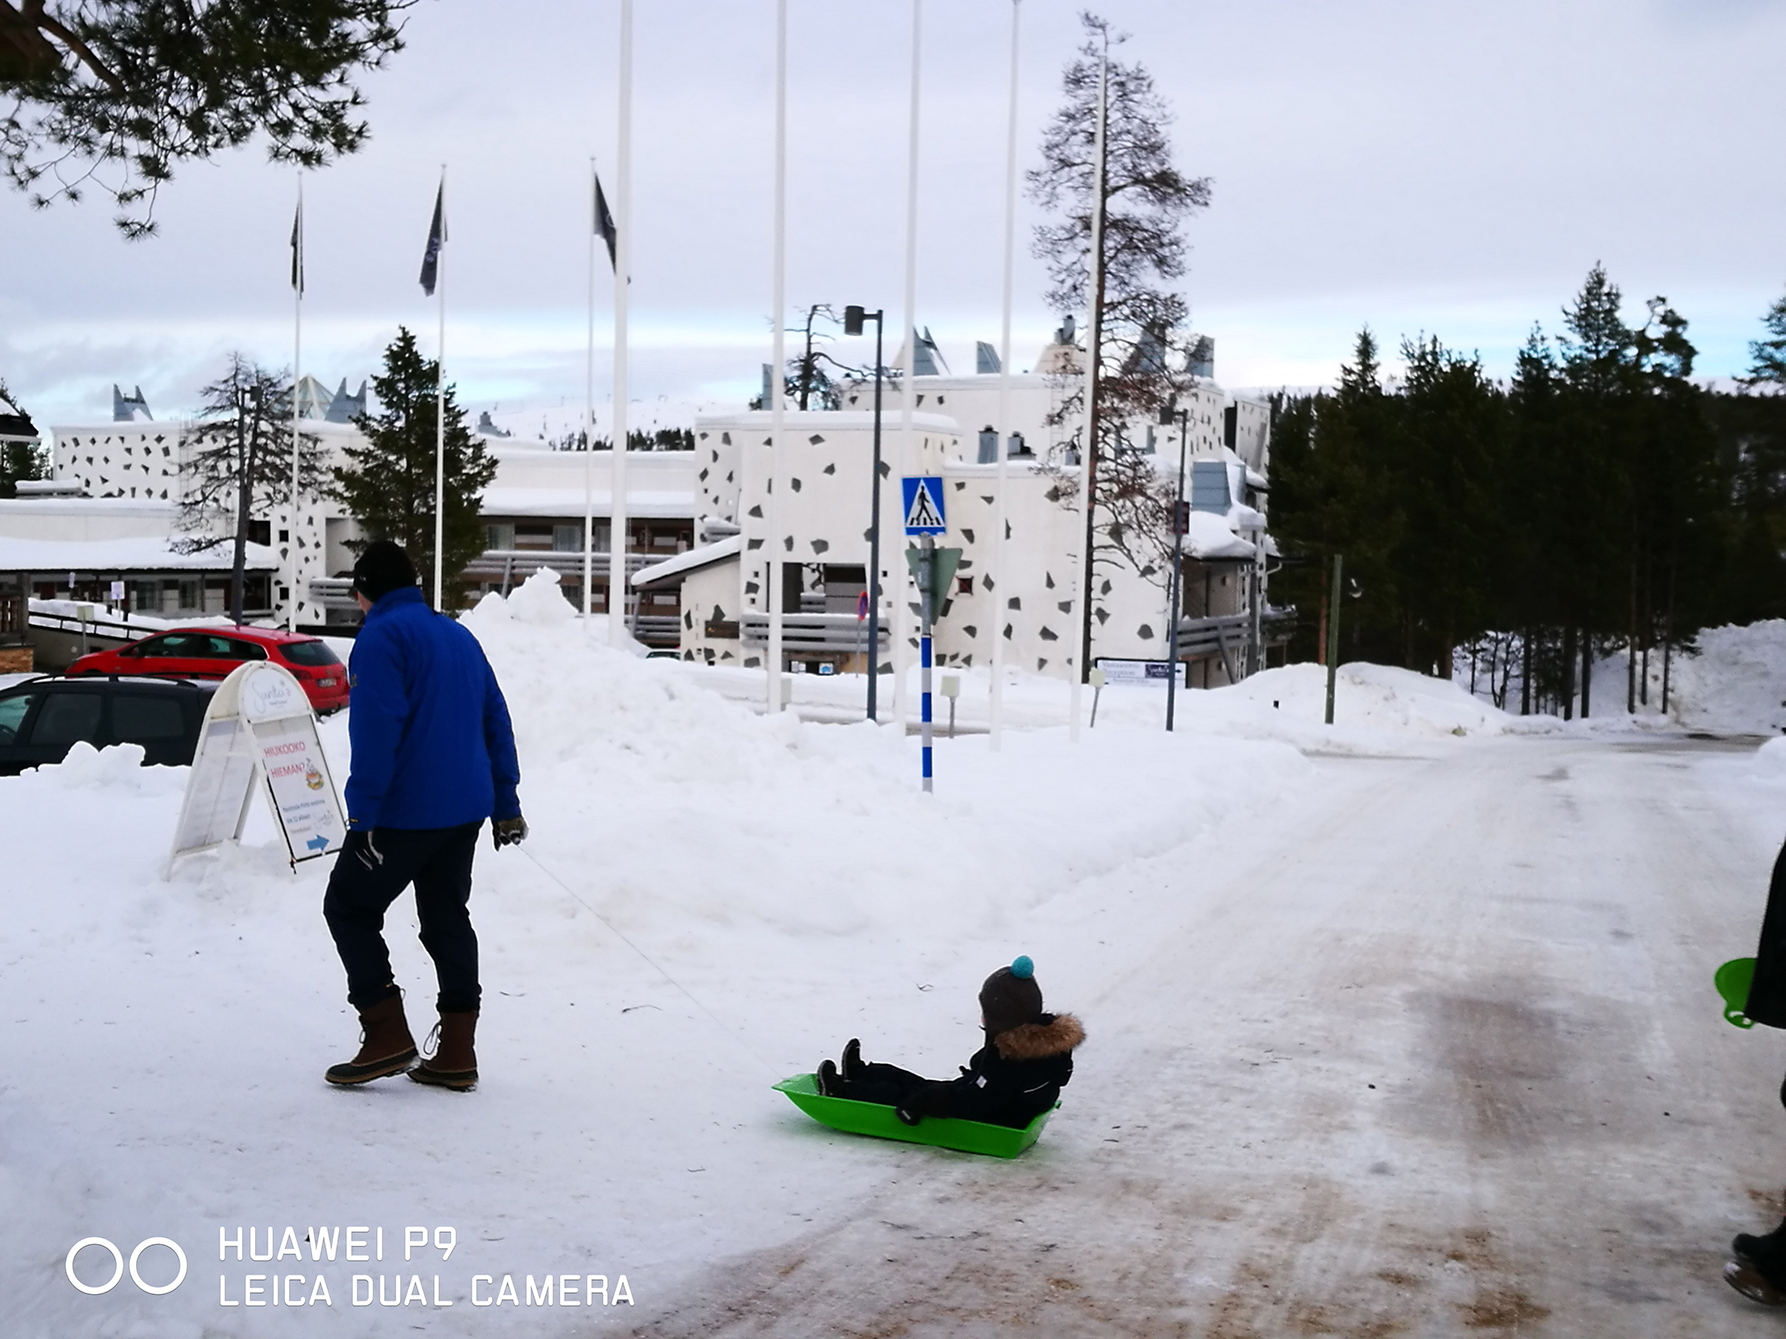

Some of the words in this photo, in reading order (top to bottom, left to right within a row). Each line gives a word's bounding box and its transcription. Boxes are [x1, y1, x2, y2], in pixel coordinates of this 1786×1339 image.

[252, 680, 291, 714] Santa's
[263, 741, 306, 758] HIUKOOKO
[270, 762, 305, 778] HIEMAN?
